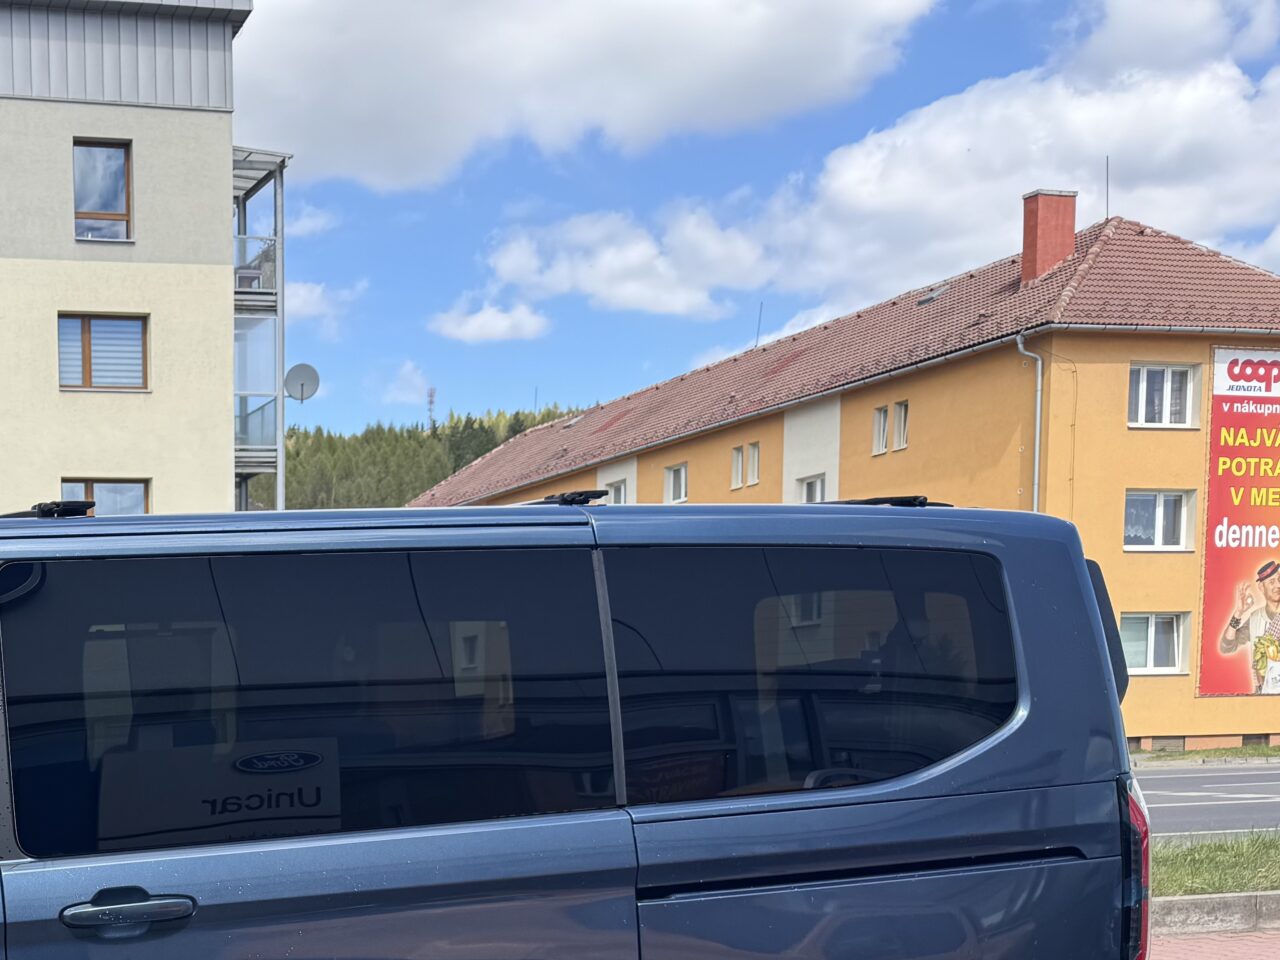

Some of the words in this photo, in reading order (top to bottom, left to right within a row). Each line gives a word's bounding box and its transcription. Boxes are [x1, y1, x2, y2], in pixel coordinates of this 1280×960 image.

[1222, 402, 1230, 412] v
[1230, 487, 1244, 506] V
[1215, 517, 1280, 548] denne
